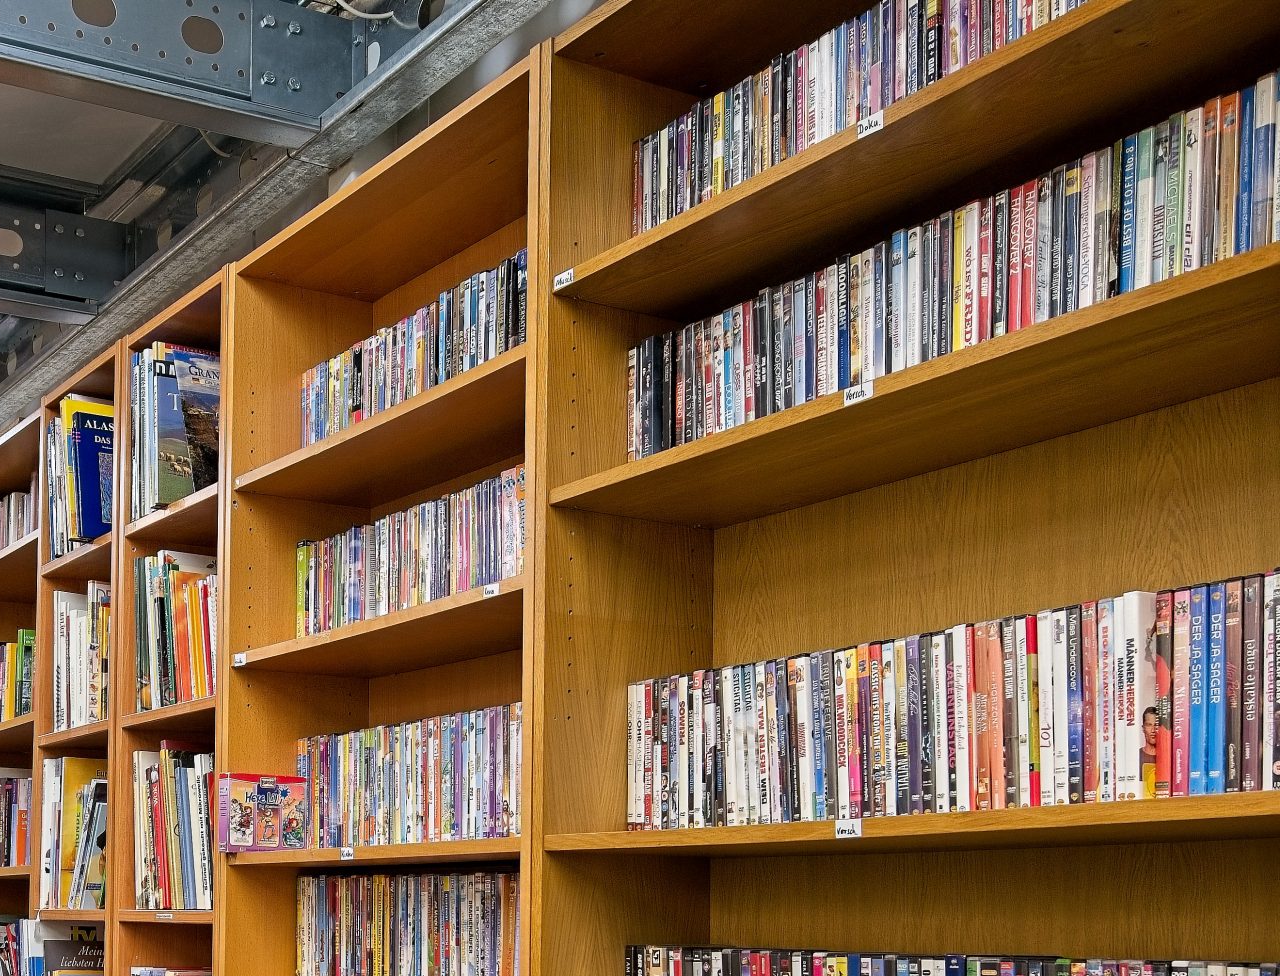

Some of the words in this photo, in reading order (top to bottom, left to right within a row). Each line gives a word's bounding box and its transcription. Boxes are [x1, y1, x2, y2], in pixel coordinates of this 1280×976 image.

[1024, 192, 1035, 257] HANGOVER
[1124, 208, 1133, 220] OF
[1010, 198, 1021, 265] HANGOVER
[1123, 222, 1133, 245] BEST
[1153, 205, 1164, 260] KLITSCHKO
[1010, 266, 1018, 275] 2
[1024, 258, 1033, 269] 2
[838, 264, 847, 331] MOONLIGHT
[189, 366, 219, 380] GRAN
[84, 419, 114, 431] ALAS
[94, 435, 110, 444] DAS
[1069, 615, 1077, 636] Miss
[1192, 616, 1201, 641] DER
[1211, 614, 1221, 639] DER
[1069, 639, 1077, 691] Undercover
[1244, 639, 1255, 671] engel
[822, 662, 830, 687] TRUE
[1192, 646, 1201, 705] JA-SAGER
[1210, 644, 1221, 704] JA-SAGER
[1245, 674, 1255, 721] eiskalte
[824, 689, 832, 741] DETECTIVE
[897, 740, 906, 757] JOB
[897, 758, 909, 791] ITALIAN
[60, 956, 94, 968] liebsten
[78, 946, 104, 956] Mein
